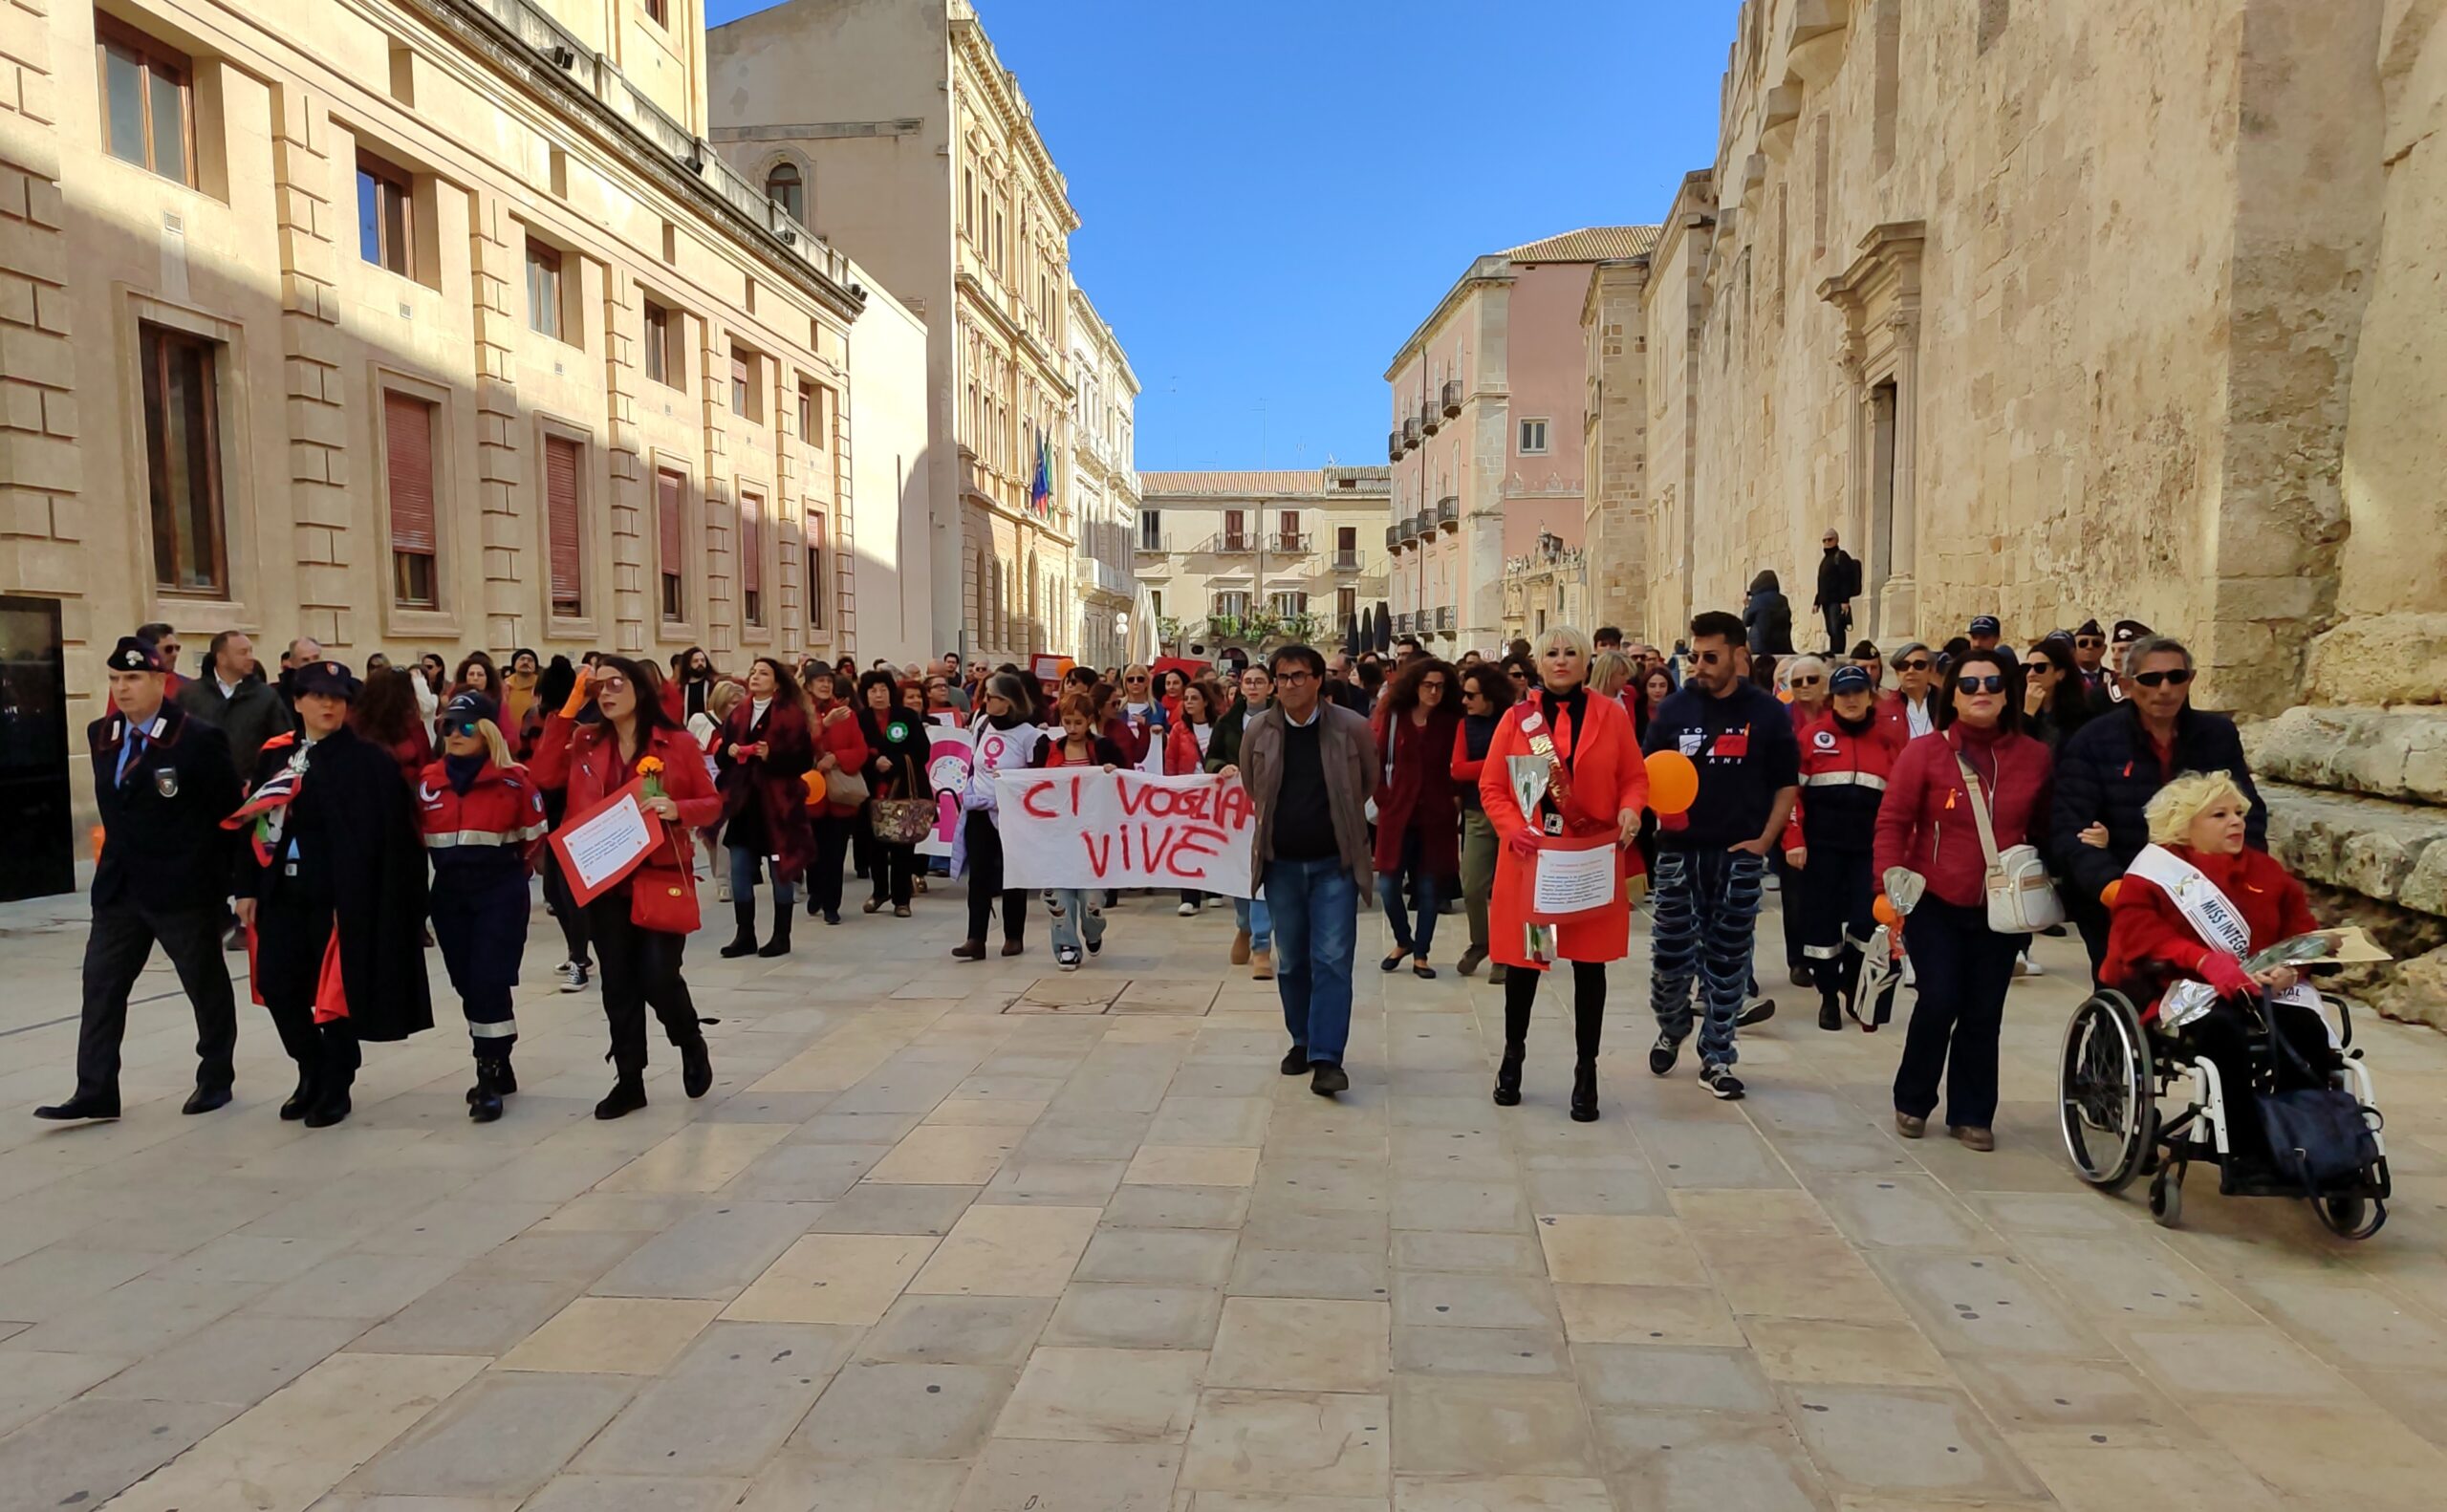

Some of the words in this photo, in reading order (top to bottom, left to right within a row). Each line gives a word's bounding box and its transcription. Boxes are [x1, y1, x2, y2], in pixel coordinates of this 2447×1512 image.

[1023, 774, 1080, 818] CI
[1081, 824, 1228, 877] VIVE
[2199, 899, 2228, 924] MISS
